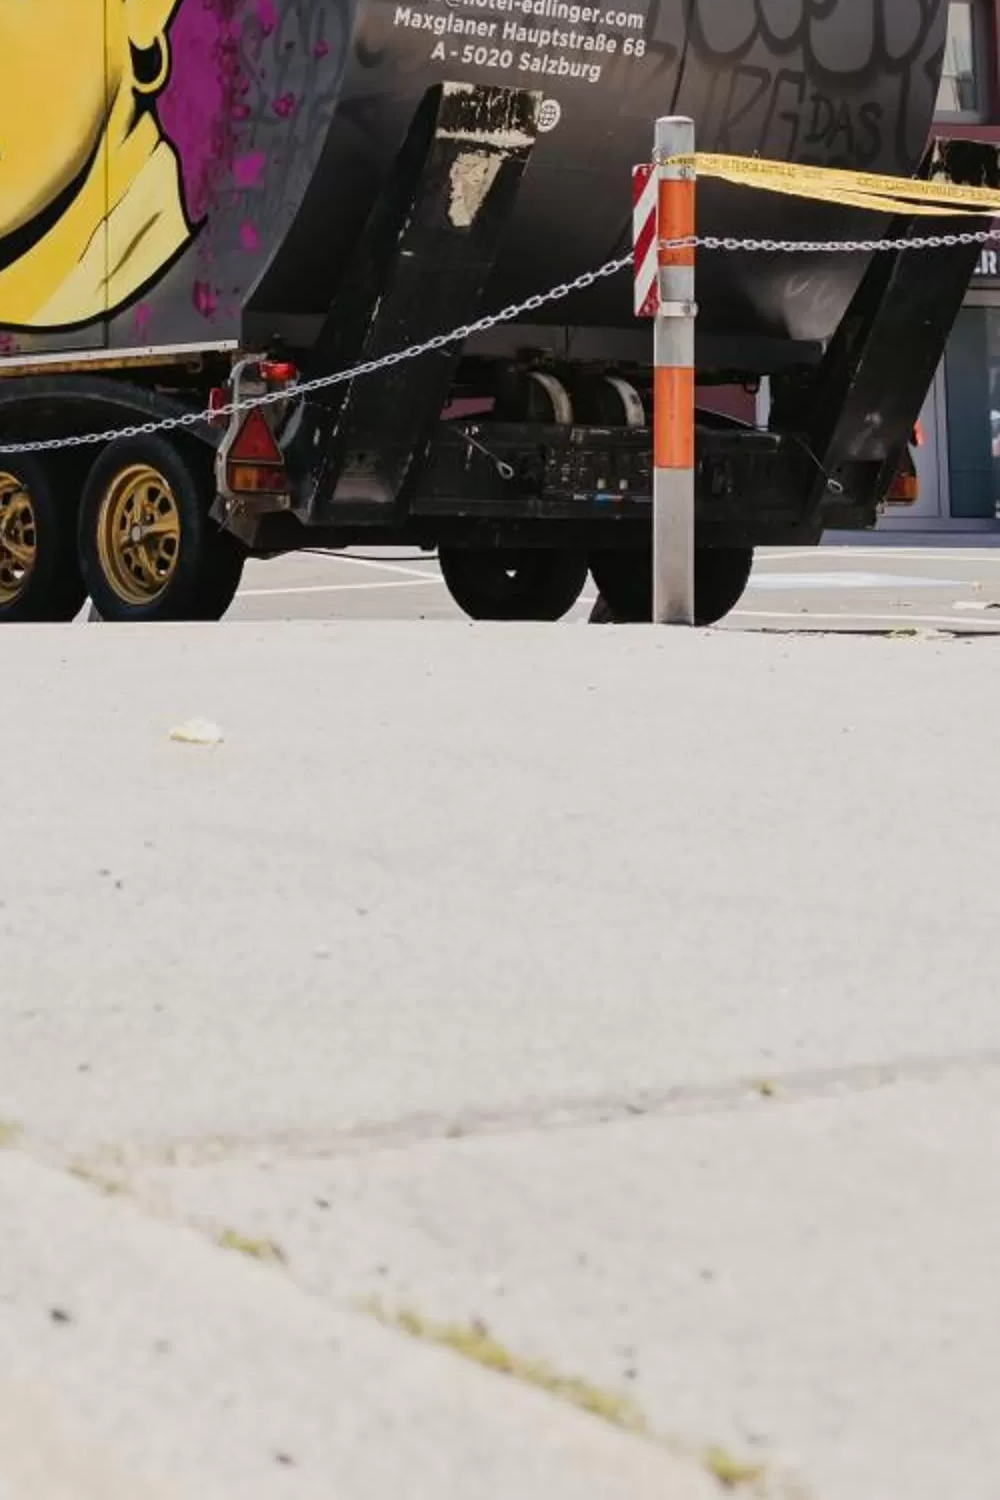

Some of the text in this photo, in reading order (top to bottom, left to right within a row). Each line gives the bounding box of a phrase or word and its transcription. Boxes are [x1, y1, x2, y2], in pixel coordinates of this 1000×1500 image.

[392, 6, 648, 57] Maxglaner Hauptstraße 68
[429, 41, 447, 62] A
[461, 44, 514, 70] 5020
[518, 52, 603, 84] Salzburg
